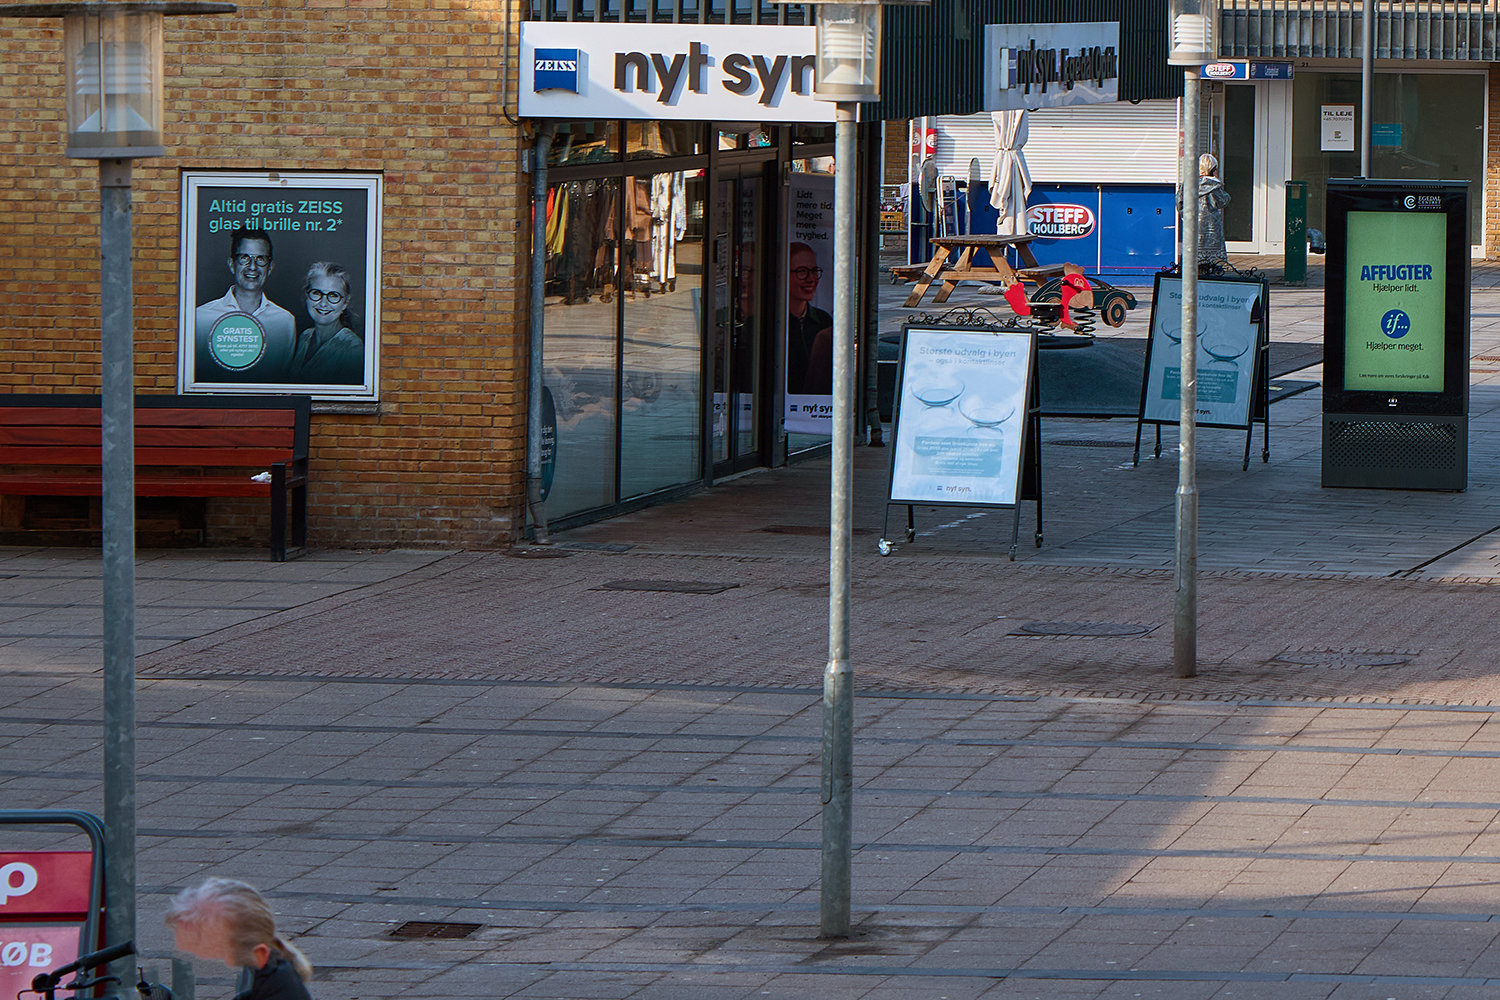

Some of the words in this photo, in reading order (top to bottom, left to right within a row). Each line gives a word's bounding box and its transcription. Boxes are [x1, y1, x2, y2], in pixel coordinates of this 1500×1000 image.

[535, 59, 576, 71] ZEISS
[614, 41, 709, 104] nyt
[796, 191, 812, 199] Lidt
[209, 199, 246, 213] Altid
[251, 200, 294, 216] gratis
[298, 201, 343, 214] ZEISS
[820, 202, 834, 210] tid.
[796, 211, 822, 220] Meget
[1034, 208, 1085, 223] STEFF
[209, 217, 241, 232] glas
[245, 217, 259, 231] til
[263, 218, 300, 231] brille
[305, 221, 323, 231] nr.
[1033, 223, 1085, 235] HOULBERG
[796, 232, 829, 241] tryghed.
[1361, 265, 1433, 281] AFFUGTER
[1373, 283, 1403, 293] Hjælper
[1405, 284, 1419, 292] lidt.
[223, 327, 253, 335] GRATIS
[216, 335, 258, 343] SYNSTEST
[1366, 342, 1396, 351] Hjælper
[1398, 342, 1424, 352] meget.
[955, 348, 986, 358] udvalg
[993, 350, 1016, 359] byen
[803, 404, 818, 413] nyt
[0, 941, 53, 968] ØB
